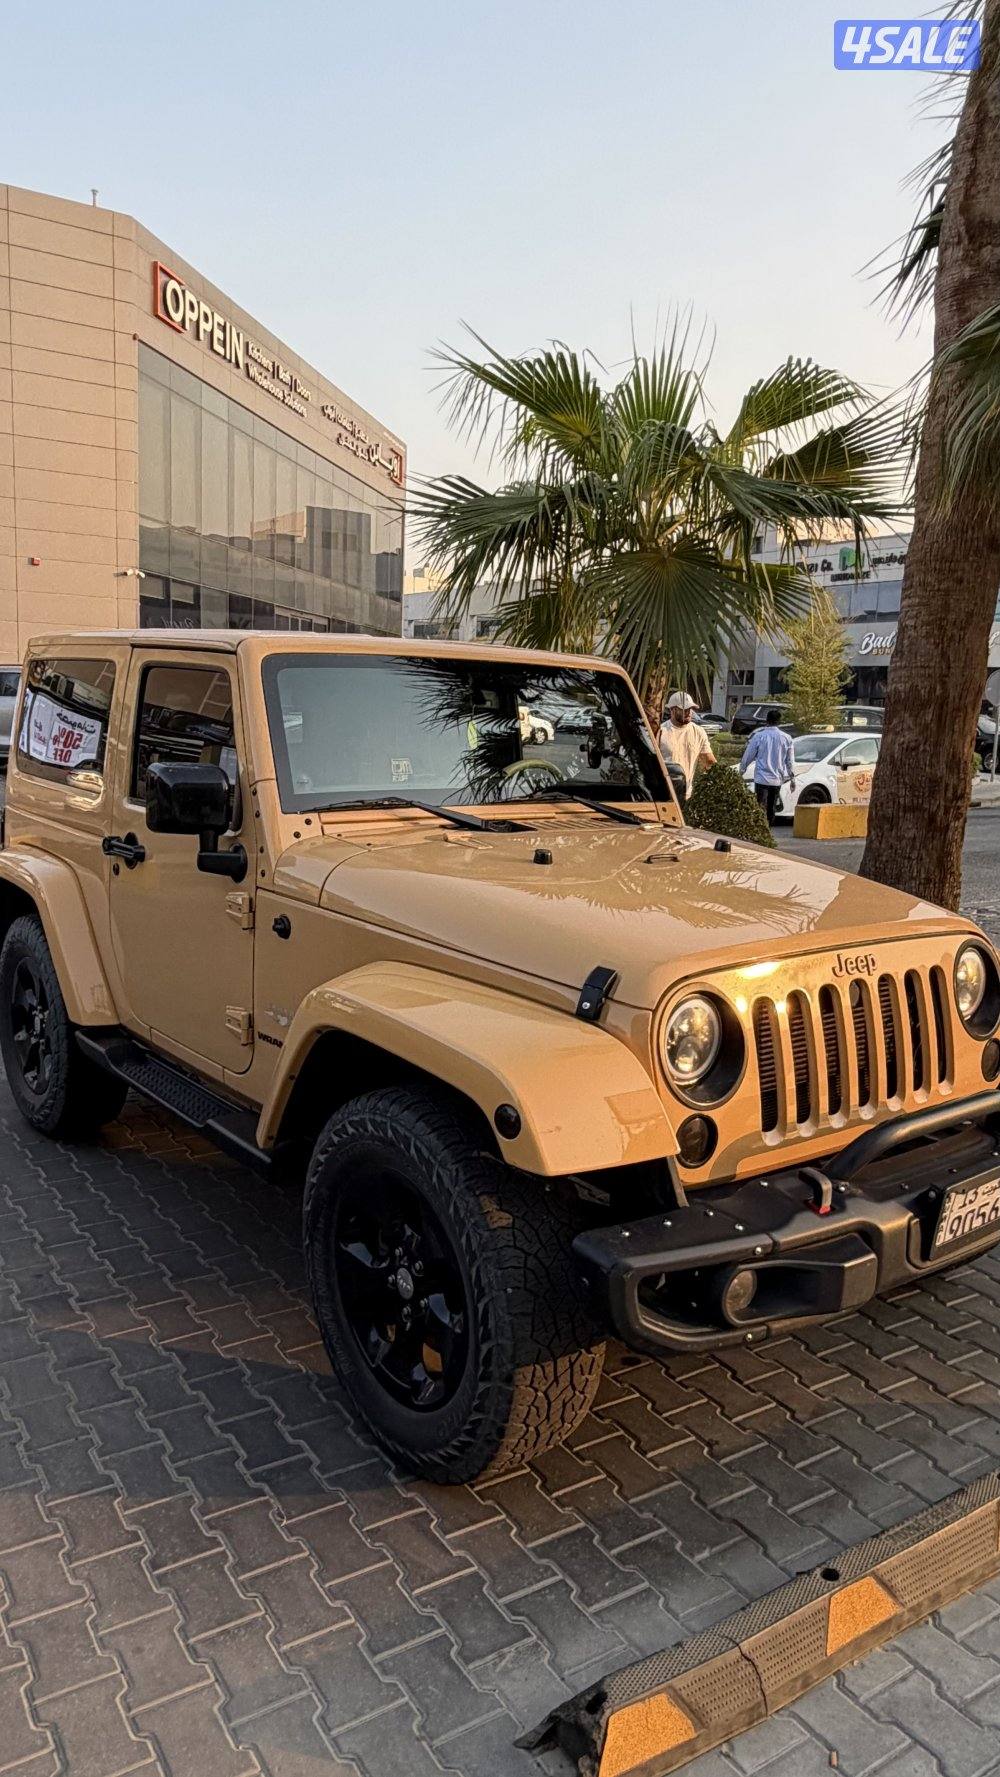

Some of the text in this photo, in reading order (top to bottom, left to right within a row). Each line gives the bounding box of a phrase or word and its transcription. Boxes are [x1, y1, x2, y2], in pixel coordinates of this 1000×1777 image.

[165, 279, 245, 370] OPPEIN
[858, 631, 896, 655] Bad
[832, 954, 877, 977] Jeep
